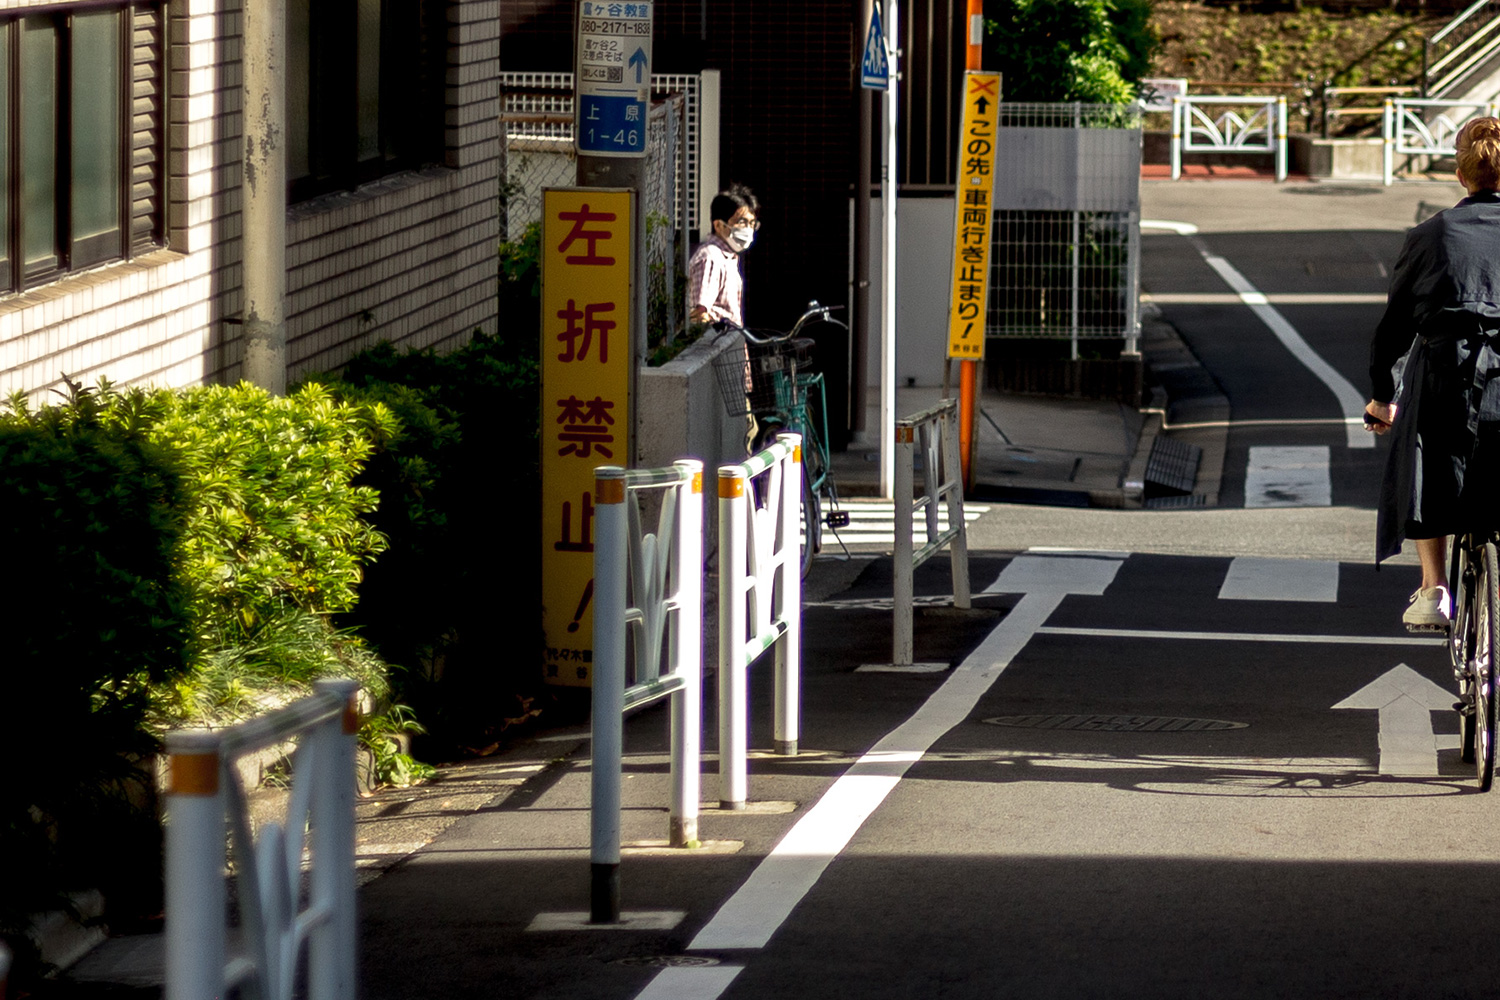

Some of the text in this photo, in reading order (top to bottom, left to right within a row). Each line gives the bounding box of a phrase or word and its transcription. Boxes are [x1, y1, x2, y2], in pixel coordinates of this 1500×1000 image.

[586, 103, 639, 122] 上原
[588, 128, 638, 147] 1-46
[966, 119, 992, 176] この先
